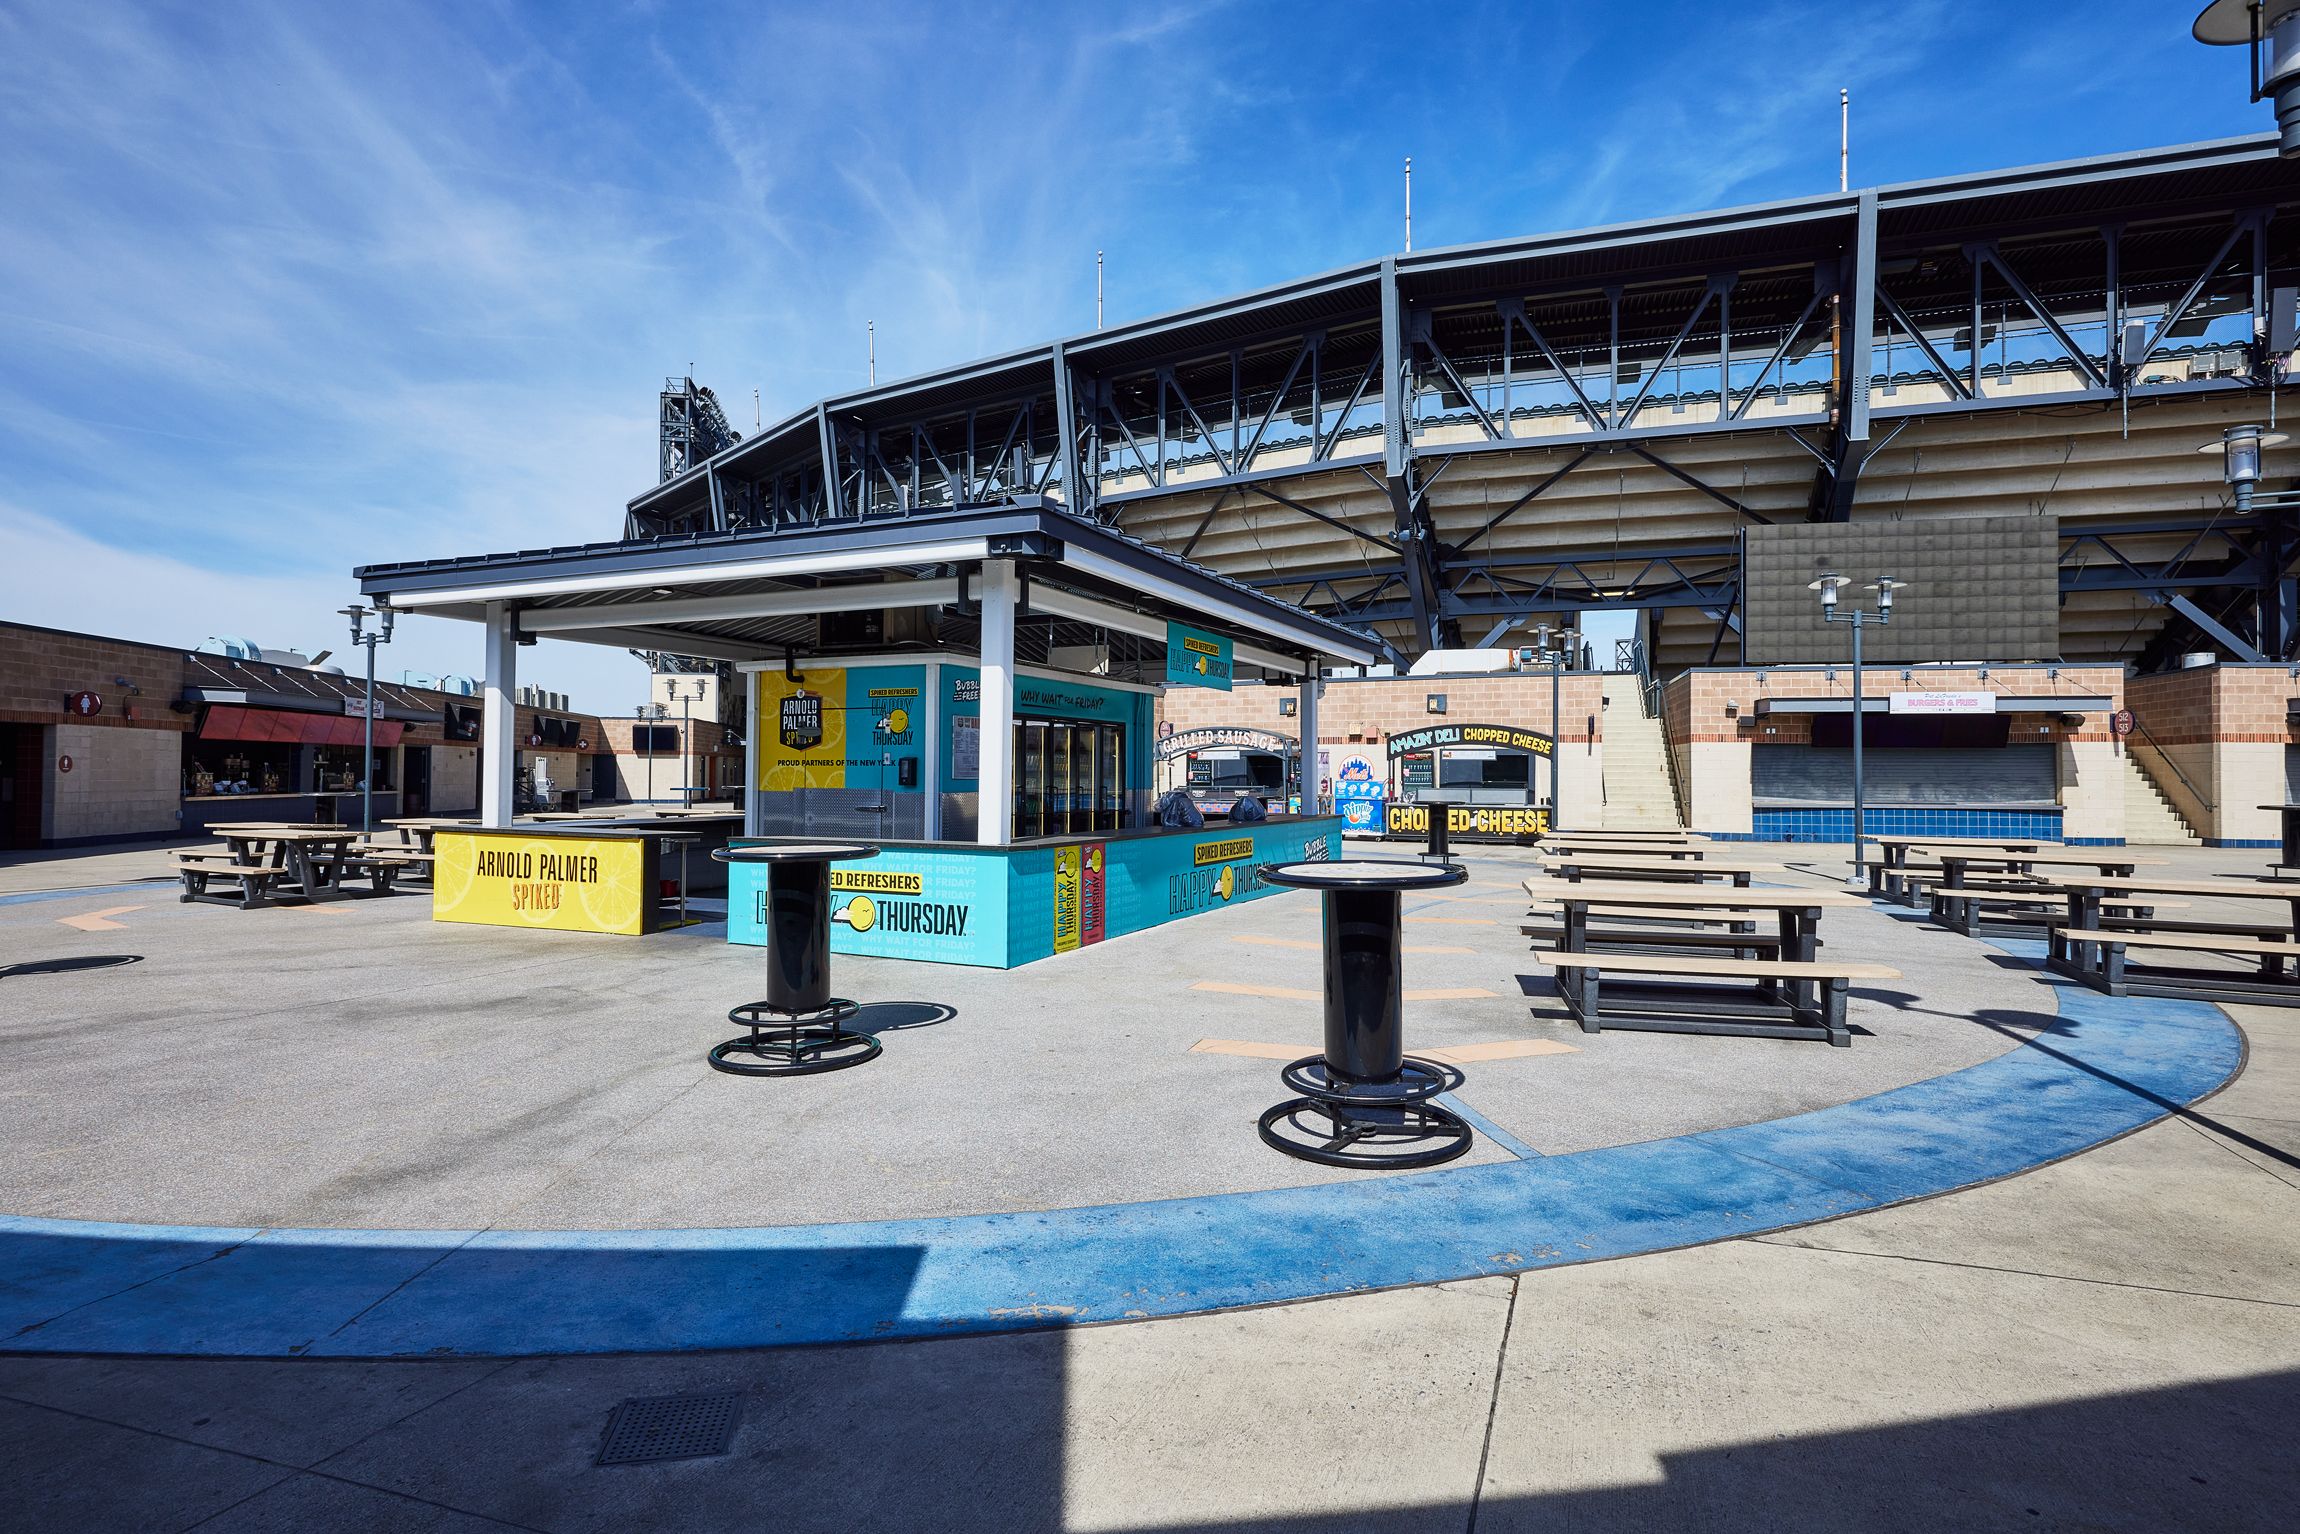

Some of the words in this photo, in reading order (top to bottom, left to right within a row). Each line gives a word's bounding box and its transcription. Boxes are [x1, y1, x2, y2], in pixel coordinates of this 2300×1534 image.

[1171, 648, 1198, 675] HAPPY
[1207, 659, 1231, 679] THURSDAY
[955, 679, 980, 691] BUBBL
[783, 700, 817, 715] ARNOLD
[1020, 690, 1041, 702] WHY
[1042, 691, 1064, 705] WAIT
[1075, 696, 1104, 710] FRIDAY?
[1907, 699, 1946, 707] BURGERS
[1947, 699, 1954, 707] &
[1956, 699, 1978, 707] FRIES
[2118, 712, 2129, 722] 512
[2118, 723, 2129, 732] 513
[872, 731, 913, 746] THURSDAY
[1163, 730, 1213, 753] GRILLED
[1217, 730, 1277, 752] SAUSAGE
[1435, 728, 1460, 743] DELI
[1464, 727, 1510, 744] CHOPPED
[1512, 732, 1553, 755] CHEESE
[777, 759, 800, 767] PROUD
[801, 759, 834, 767] PARTNERS
[836, 759, 845, 767] OF
[846, 759, 858, 767] THE
[860, 759, 877, 767] NEW
[1390, 808, 1470, 832] CHOED
[1477, 808, 1549, 833] CHEESE
[1196, 843, 1219, 861] SPIKED
[1219, 839, 1253, 858] REFRESHERS
[1304, 835, 1327, 858] BUBBLE
[477, 850, 532, 879] ARNOLD
[540, 853, 598, 883] PALMER
[846, 872, 920, 890] REFRESHERS
[1169, 867, 1217, 915] HAPPY
[1057, 882, 1067, 938] HAPPY
[1066, 880, 1075, 935] THURSDAY
[1084, 878, 1093, 932] HAPPY
[1092, 876, 1100, 929] THURSDAY
[876, 900, 969, 937] THURSDAY
